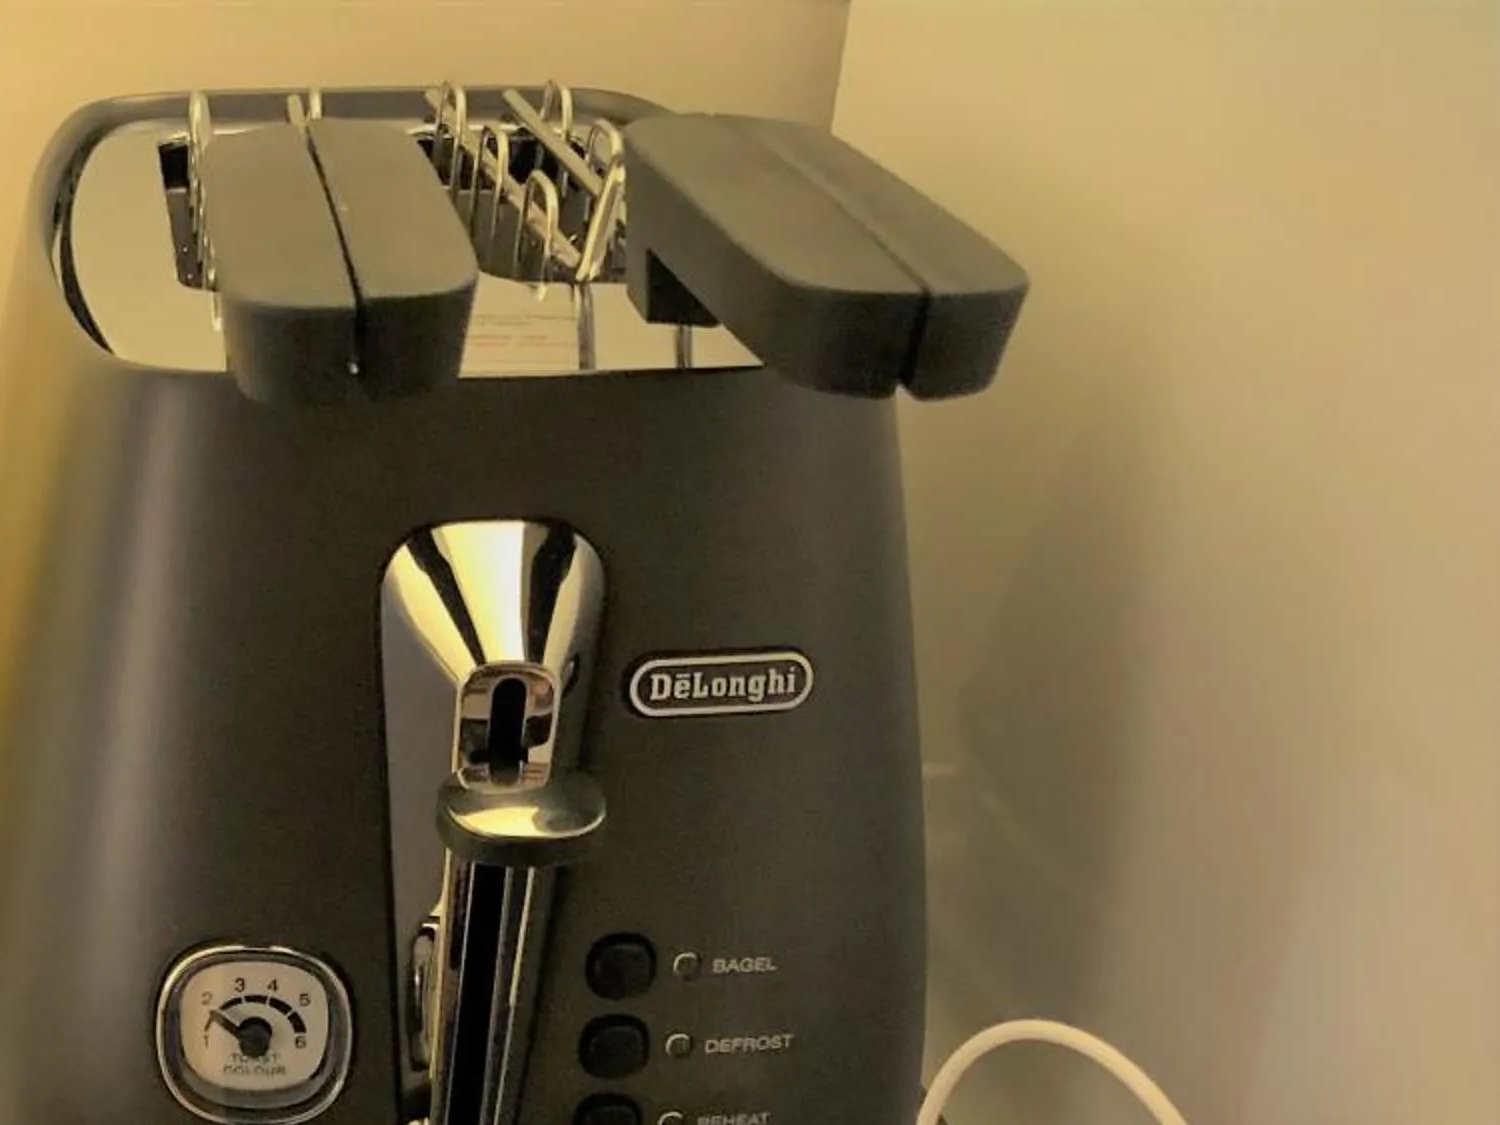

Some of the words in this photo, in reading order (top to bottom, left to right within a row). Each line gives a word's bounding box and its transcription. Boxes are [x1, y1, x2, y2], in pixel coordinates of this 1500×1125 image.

[712, 957, 777, 974] BAGEL
[234, 977, 246, 993] 3
[267, 979, 278, 992] 4
[201, 991, 213, 1006] 2
[300, 993, 312, 1008] 5
[295, 1035, 307, 1049] 6
[704, 1033, 795, 1054] DEFROST
